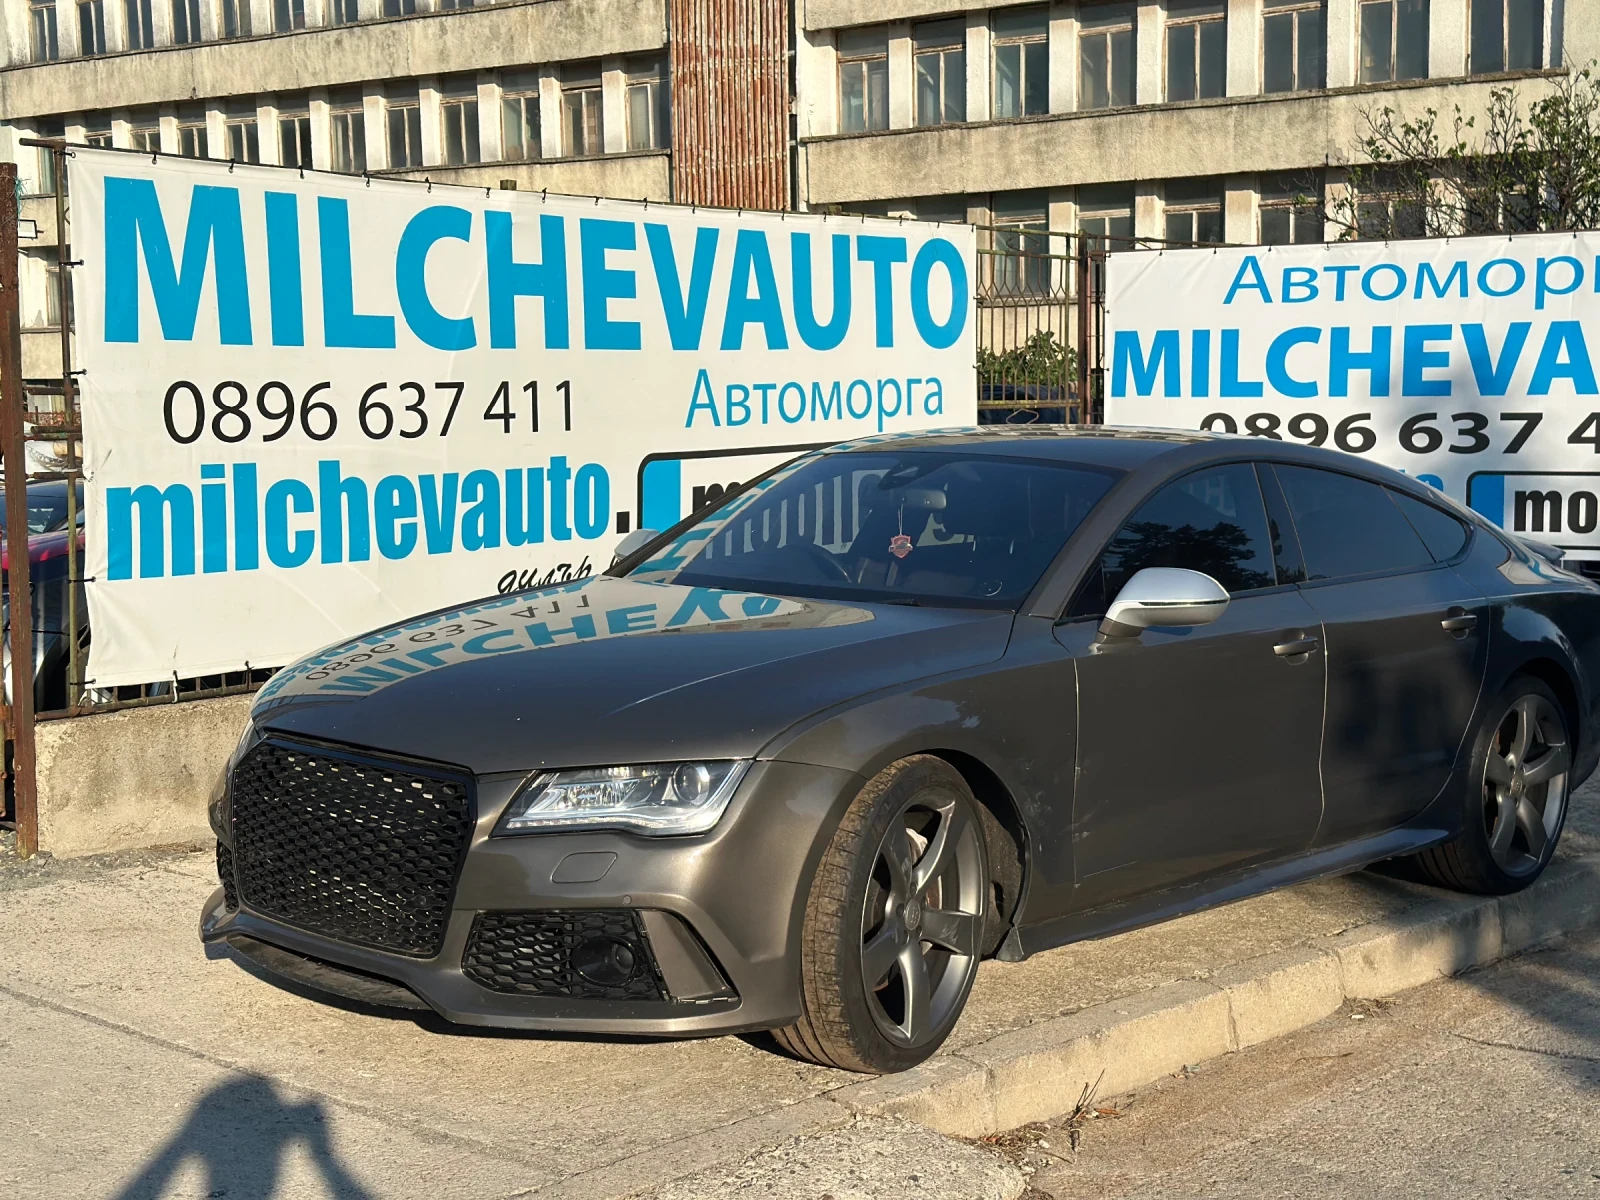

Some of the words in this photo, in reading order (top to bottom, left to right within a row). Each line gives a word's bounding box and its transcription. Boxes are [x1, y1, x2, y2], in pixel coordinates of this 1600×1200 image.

[104, 177, 968, 351] MILCHEVAUTO
[1223, 255, 1600, 311] Автомор
[1111, 320, 1599, 399] MILCHEVA
[163, 380, 338, 445] 0896
[358, 381, 465, 440] 637
[483, 380, 571, 434] 411
[685, 368, 943, 432] Автоморга
[1399, 412, 1543, 454] 637
[1567, 412, 1600, 454] 4
